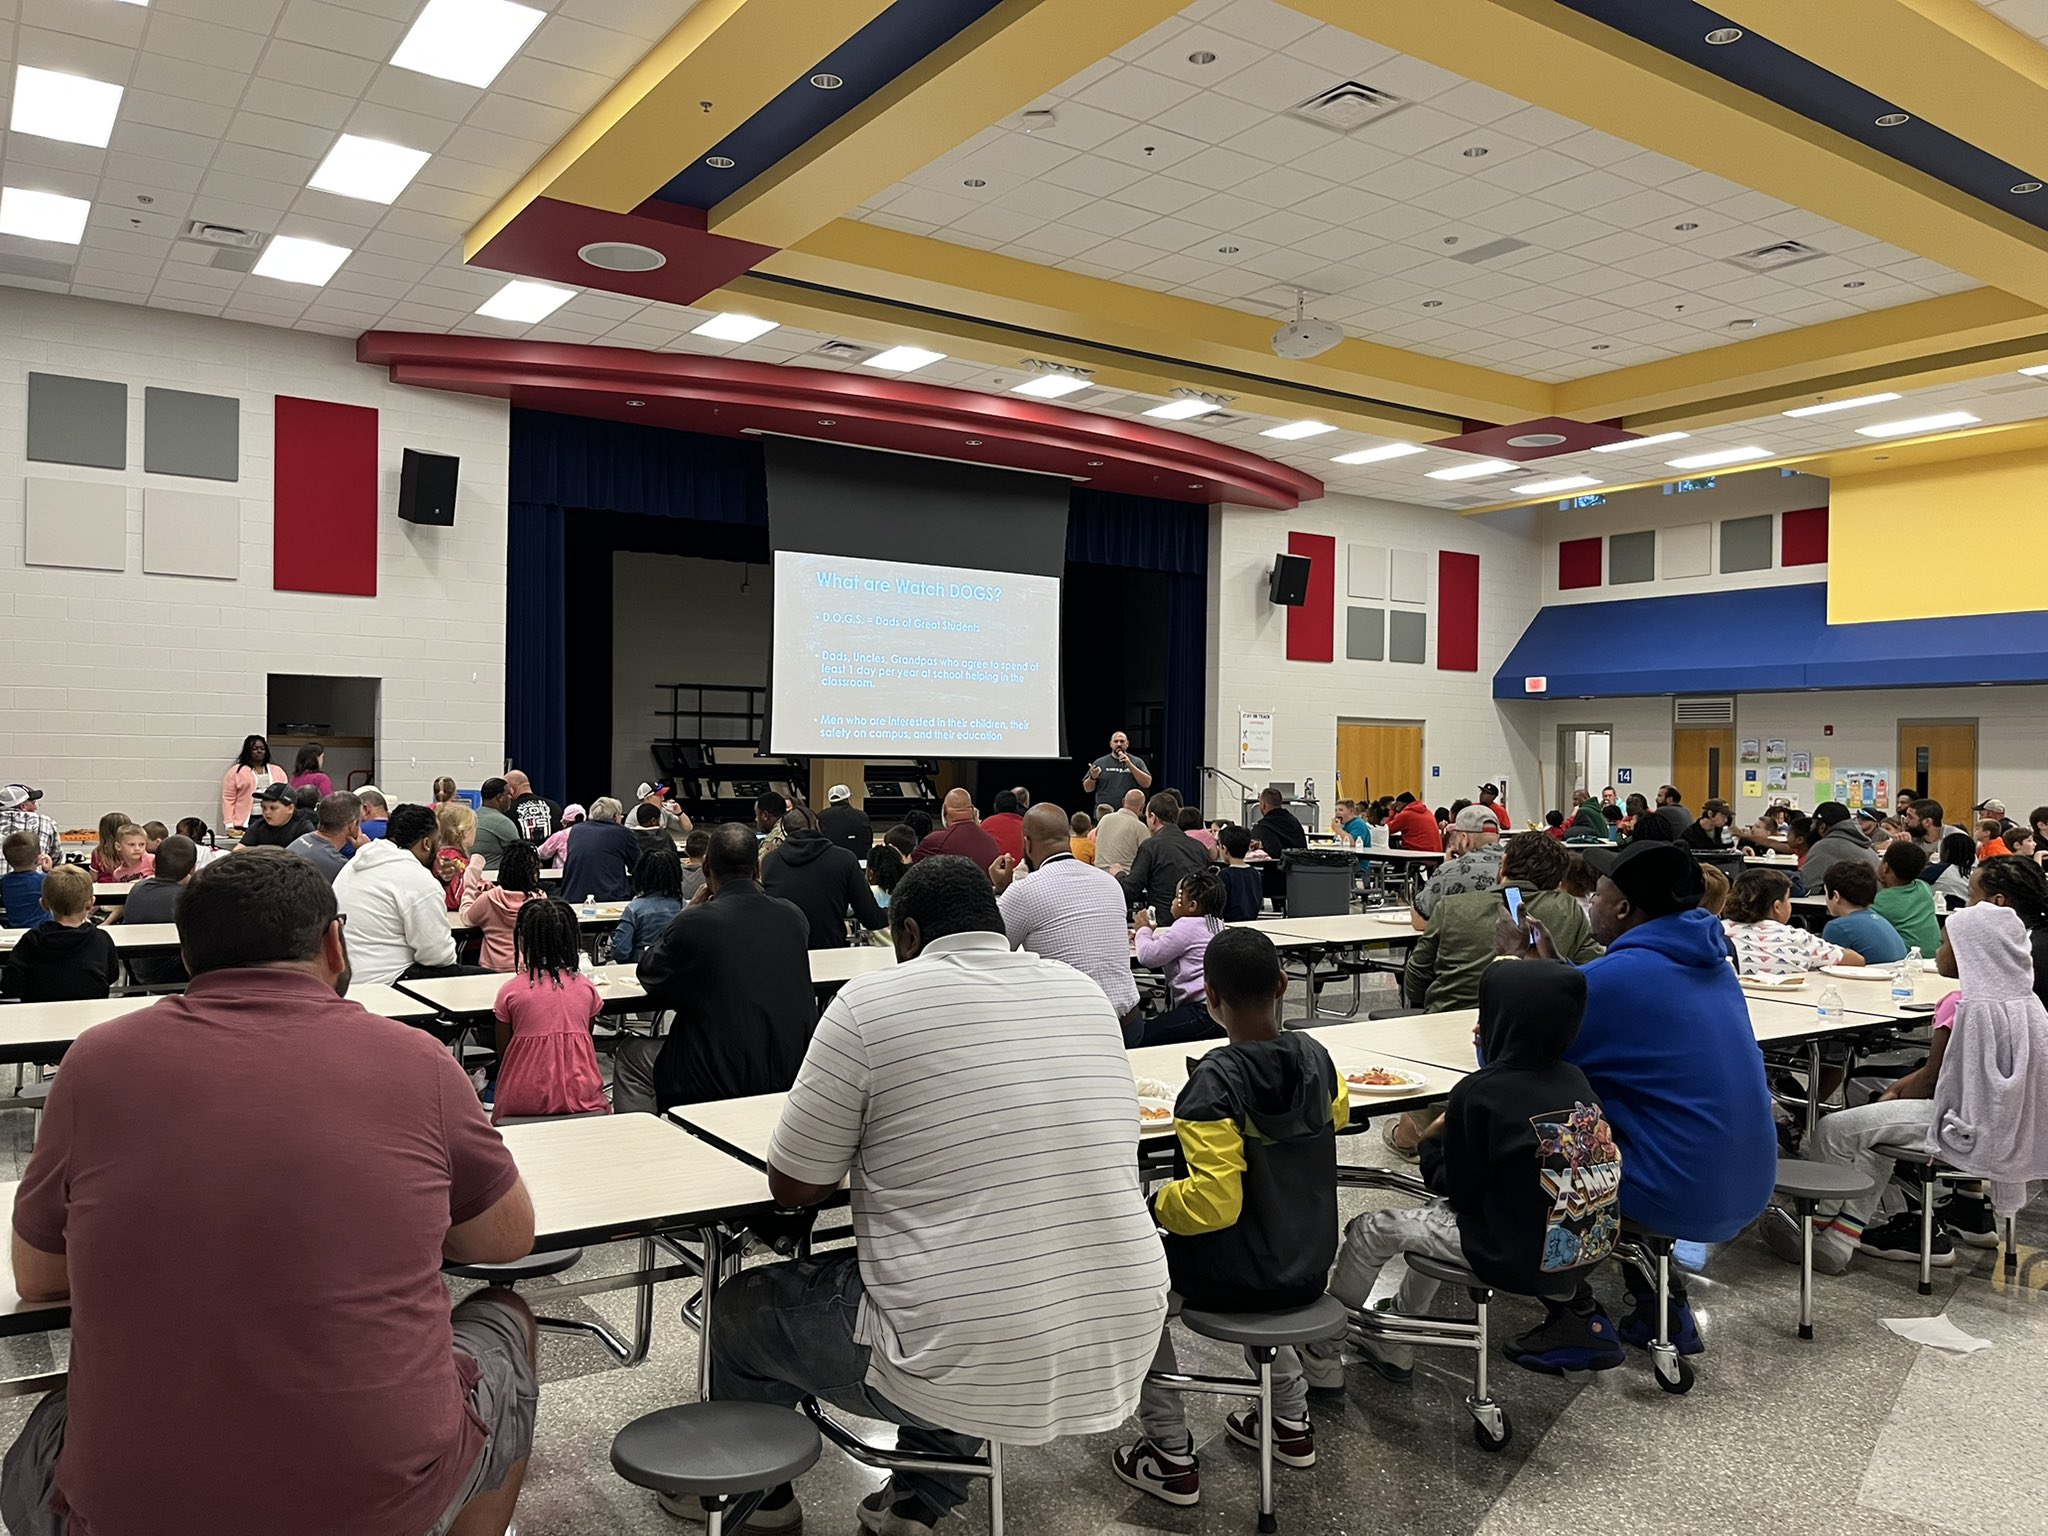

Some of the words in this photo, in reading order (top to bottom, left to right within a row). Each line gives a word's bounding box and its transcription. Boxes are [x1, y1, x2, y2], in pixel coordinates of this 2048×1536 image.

[816, 571, 860, 590] What
[864, 577, 890, 592] are
[896, 578, 945, 597] Watch
[950, 583, 1002, 601] DOGS?
[822, 612, 864, 624] D.O.G.S.
[875, 616, 900, 627] Dads
[902, 617, 912, 628] of
[914, 618, 941, 630] Great
[942, 620, 981, 632] Students
[822, 650, 850, 663] Dads,
[853, 652, 888, 664] Uncles,
[890, 654, 938, 667] Grandpas
[940, 657, 959, 667] who
[961, 659, 988, 670] agree
[990, 659, 999, 669] to
[1000, 661, 1028, 672] spend
[1029, 662, 1039, 672] at
[821, 663, 846, 674] least
[856, 665, 876, 677] day
[879, 667, 895, 677] per
[897, 668, 920, 679] year
[921, 668, 931, 678] at
[932, 670, 963, 680] school
[965, 670, 998, 683] helping
[1001, 671, 1009, 682] in
[1011, 672, 1025, 683] the
[821, 676, 876, 688] classroom.
[820, 714, 843, 725] Men
[846, 715, 867, 726] who
[869, 717, 886, 726] are
[888, 716, 935, 727] interested
[937, 717, 946, 728] in
[948, 718, 968, 728] their
[969, 718, 1008, 730] children,
[1010, 719, 1030, 730] their
[820, 727, 851, 739] safety
[853, 729, 867, 738] on
[869, 730, 911, 740] campus,
[913, 729, 932, 739] and
[934, 729, 955, 740] their
[957, 730, 1003, 741] education
[1619, 770, 1630, 782] 14
[1540, 1160, 1621, 1224] X-MEN
